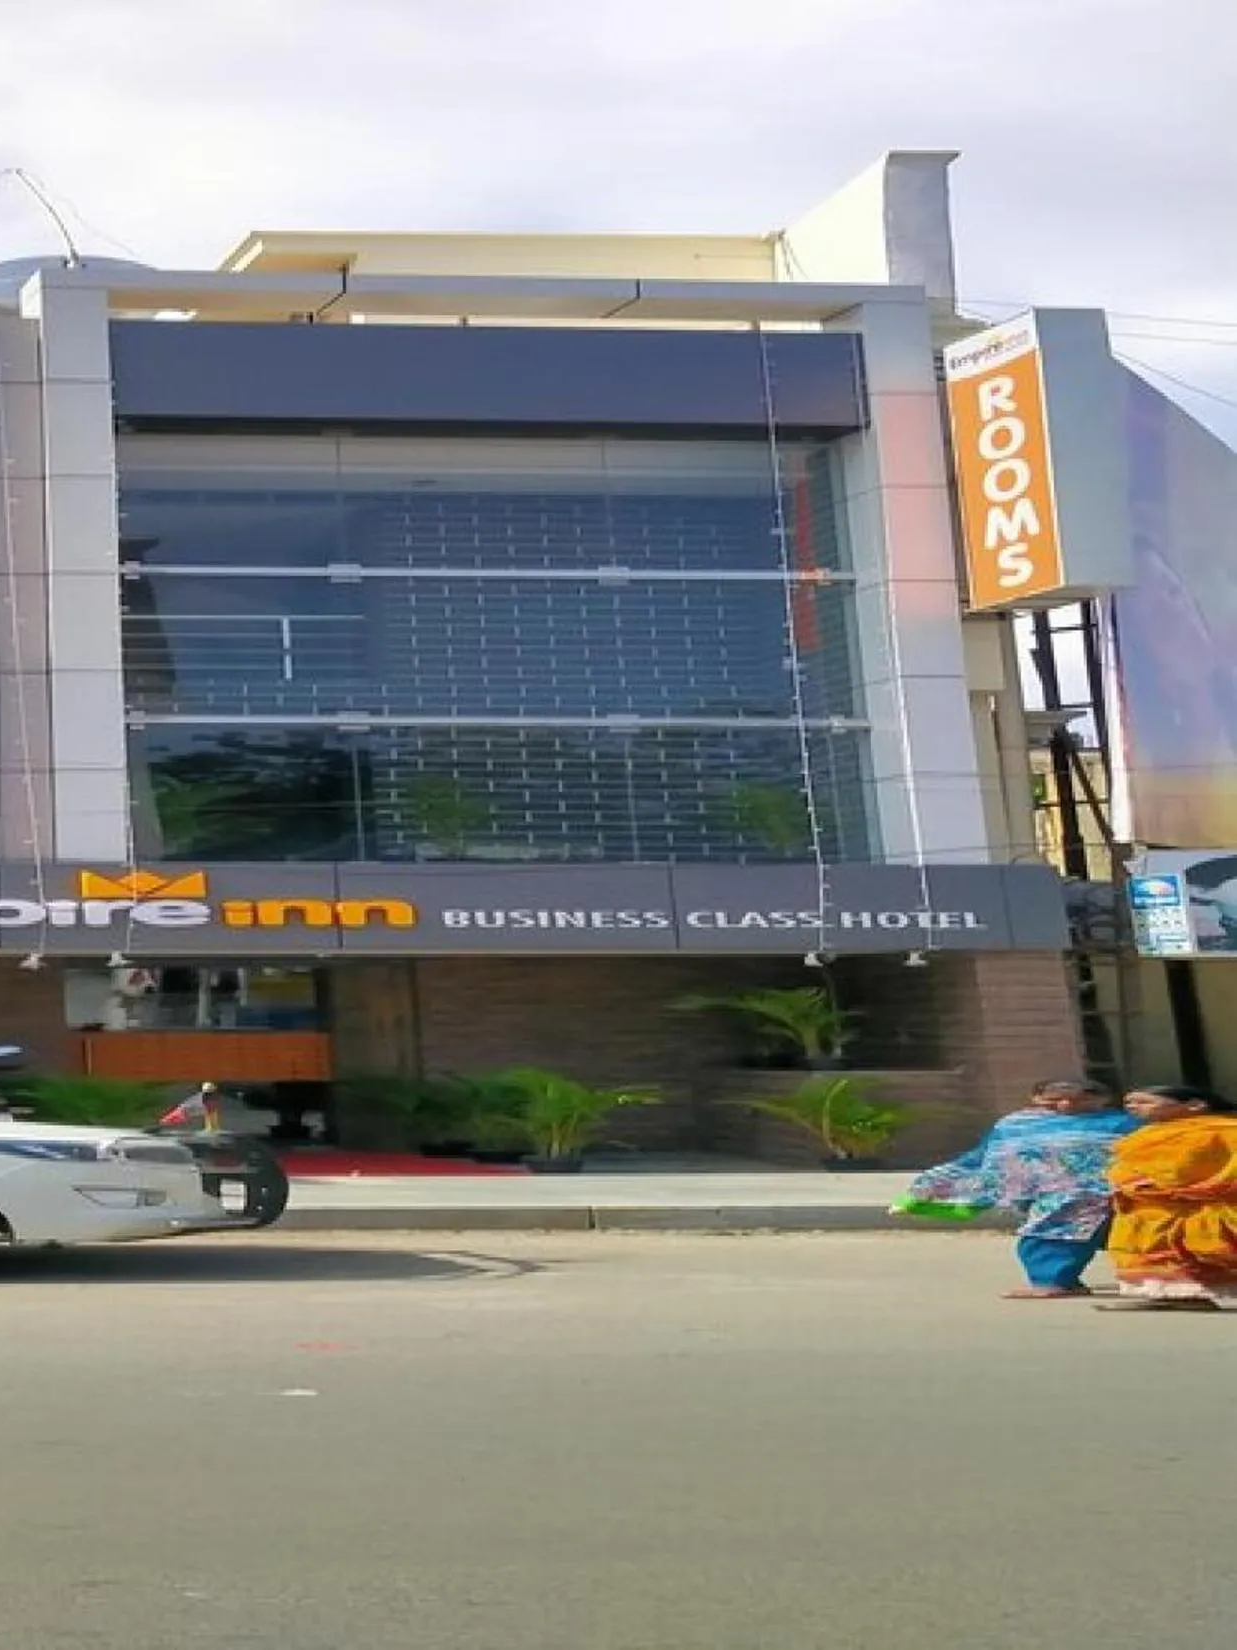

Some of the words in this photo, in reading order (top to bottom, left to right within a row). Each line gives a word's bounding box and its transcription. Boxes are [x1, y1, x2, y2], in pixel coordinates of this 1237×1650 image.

[978, 377, 1040, 587] ROOMS
[222, 898, 415, 926] inn
[441, 910, 670, 929] BUSINESS
[685, 910, 824, 929] CLASS
[839, 910, 987, 929] HOTEL
